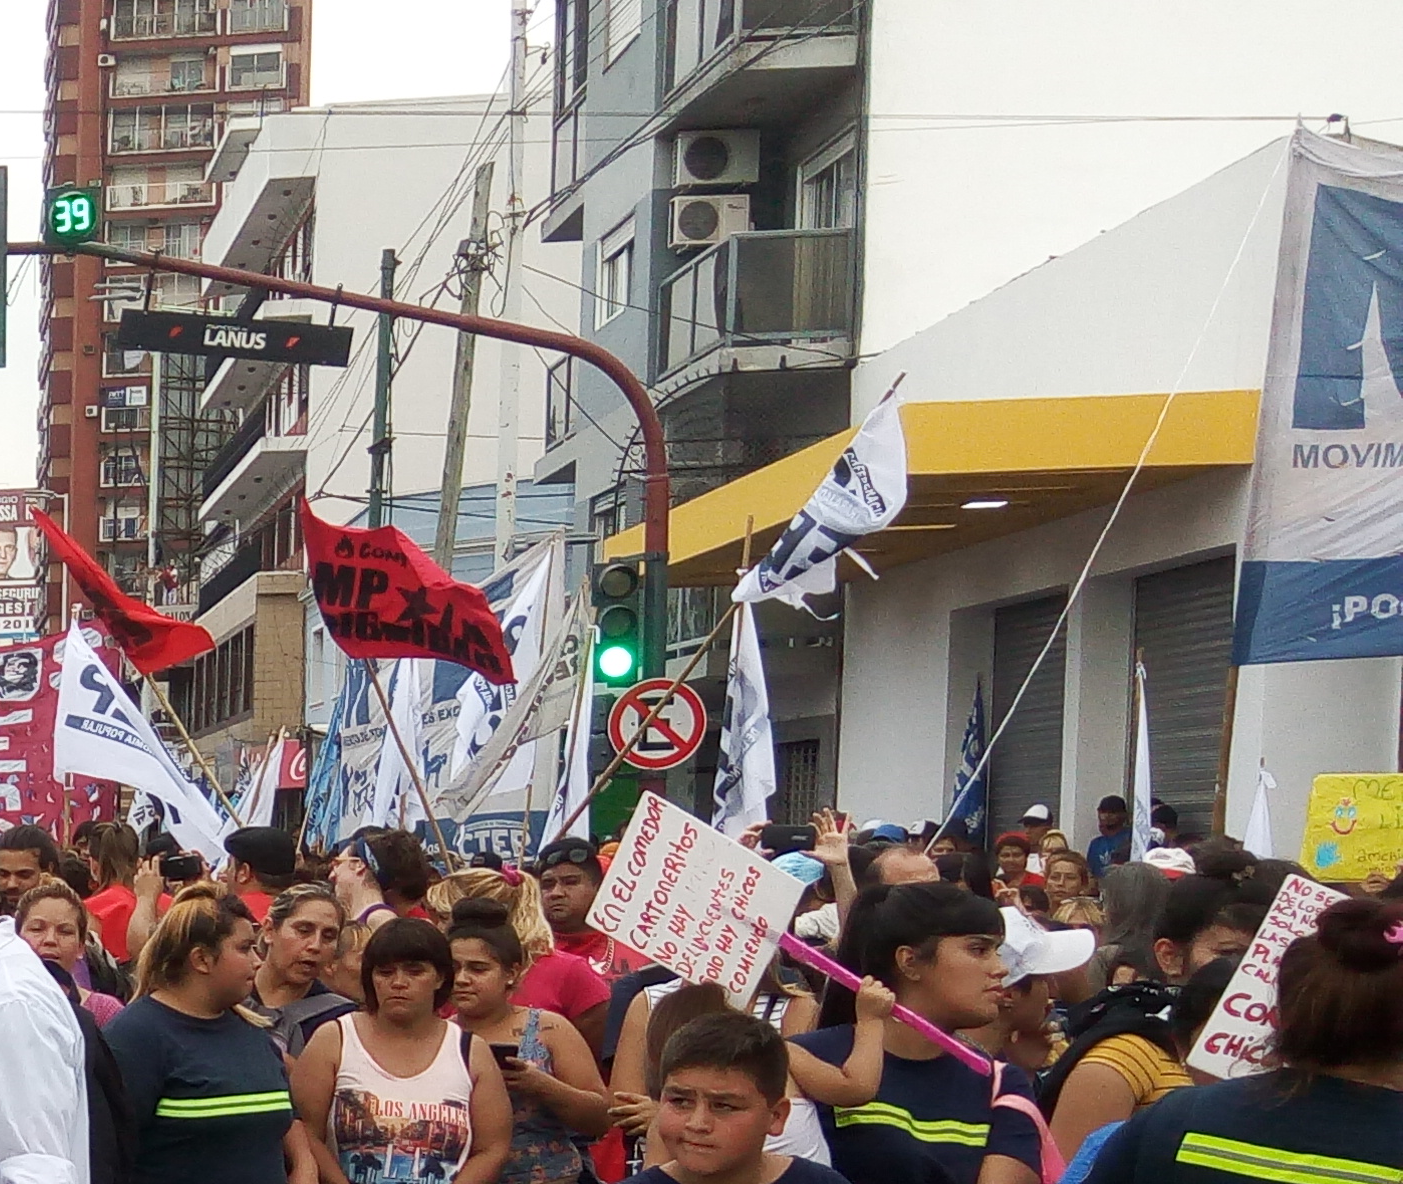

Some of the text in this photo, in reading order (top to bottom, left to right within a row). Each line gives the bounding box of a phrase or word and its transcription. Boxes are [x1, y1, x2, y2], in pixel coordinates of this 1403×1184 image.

[53, 196, 91, 232] 39
[1292, 442, 1403, 469] MOVIM
[1331, 593, 1403, 630] ¡PO
[1353, 778, 1403, 801] ME
[594, 795, 668, 933] EN EL COMEDOR
[1277, 891, 1295, 908] DE
[1286, 878, 1336, 909] NO SE
[653, 903, 695, 966] NO HAY
[715, 923, 739, 957] HAY
[1257, 928, 1291, 948] LAS
[1204, 1031, 1267, 1064] CHiC
[410, 1102, 469, 1127] ANGELES
